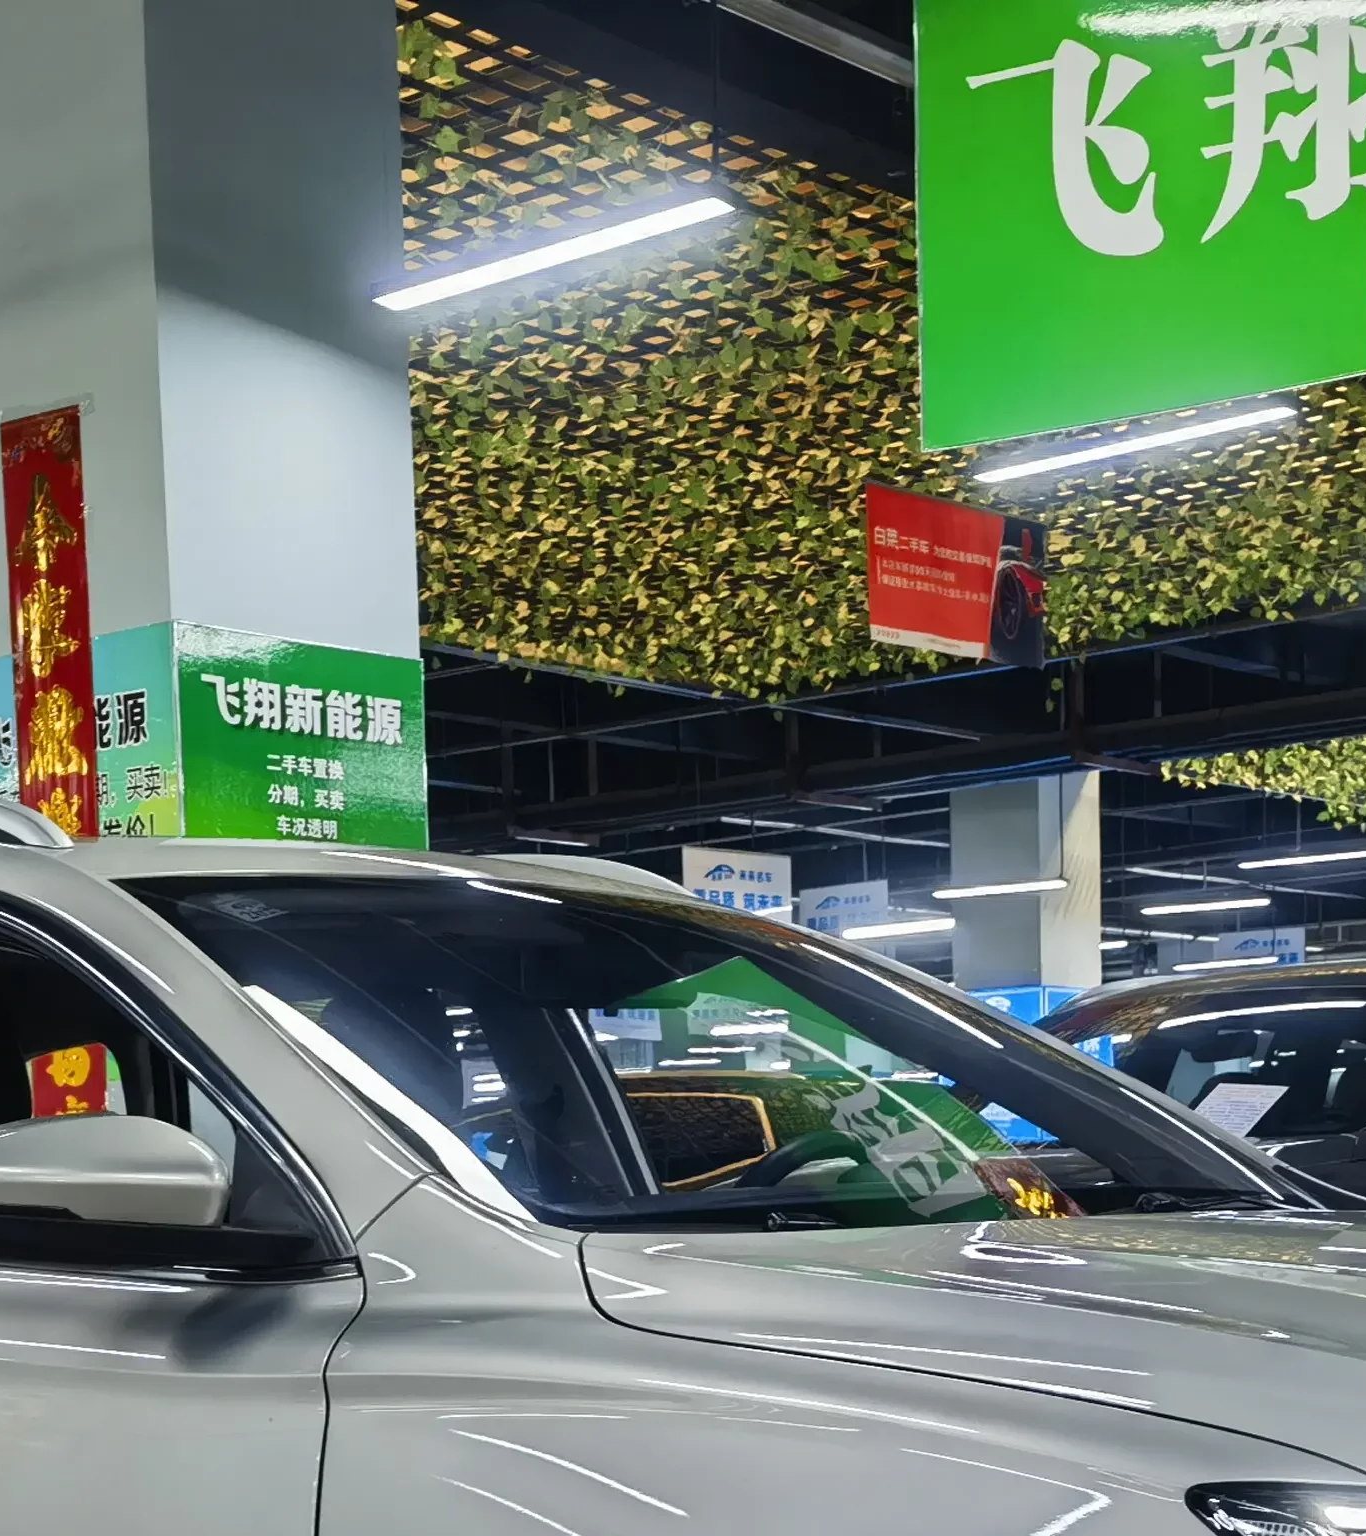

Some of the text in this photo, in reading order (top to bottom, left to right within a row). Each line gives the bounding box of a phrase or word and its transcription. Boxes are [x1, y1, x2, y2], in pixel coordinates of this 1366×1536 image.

[200, 673, 403, 745] 飞翔新能源
[266, 754, 344, 781] 二手车置换
[267, 784, 345, 811] 分期，买卖
[276, 815, 338, 840] 车况透明
